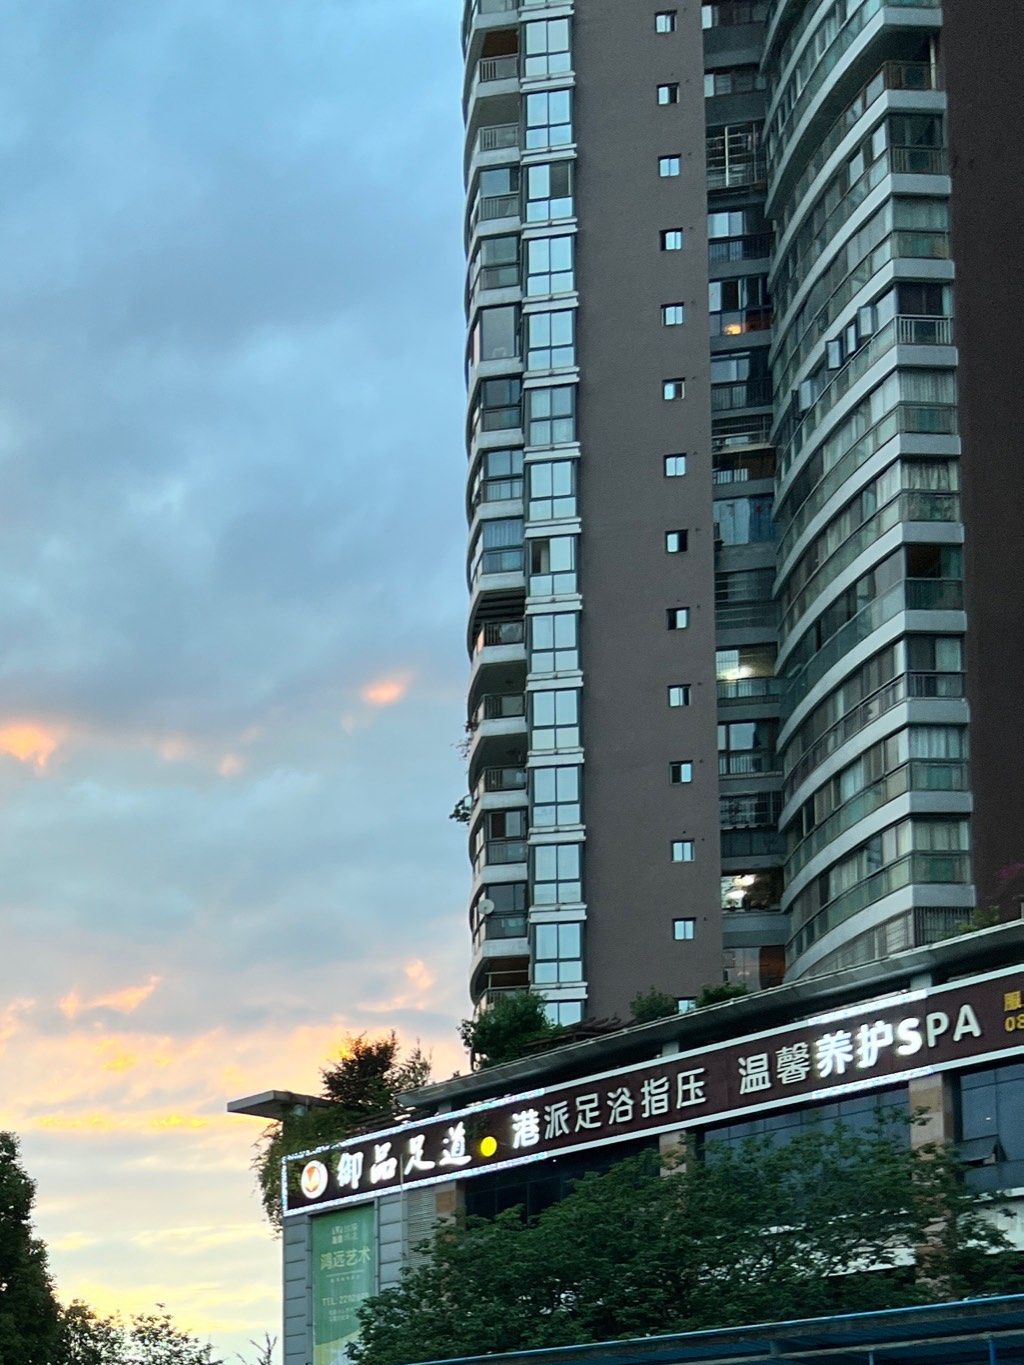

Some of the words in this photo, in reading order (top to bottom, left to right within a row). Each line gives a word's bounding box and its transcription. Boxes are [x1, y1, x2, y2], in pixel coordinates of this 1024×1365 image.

[511, 1068, 707, 1149] 港派足浴指压
